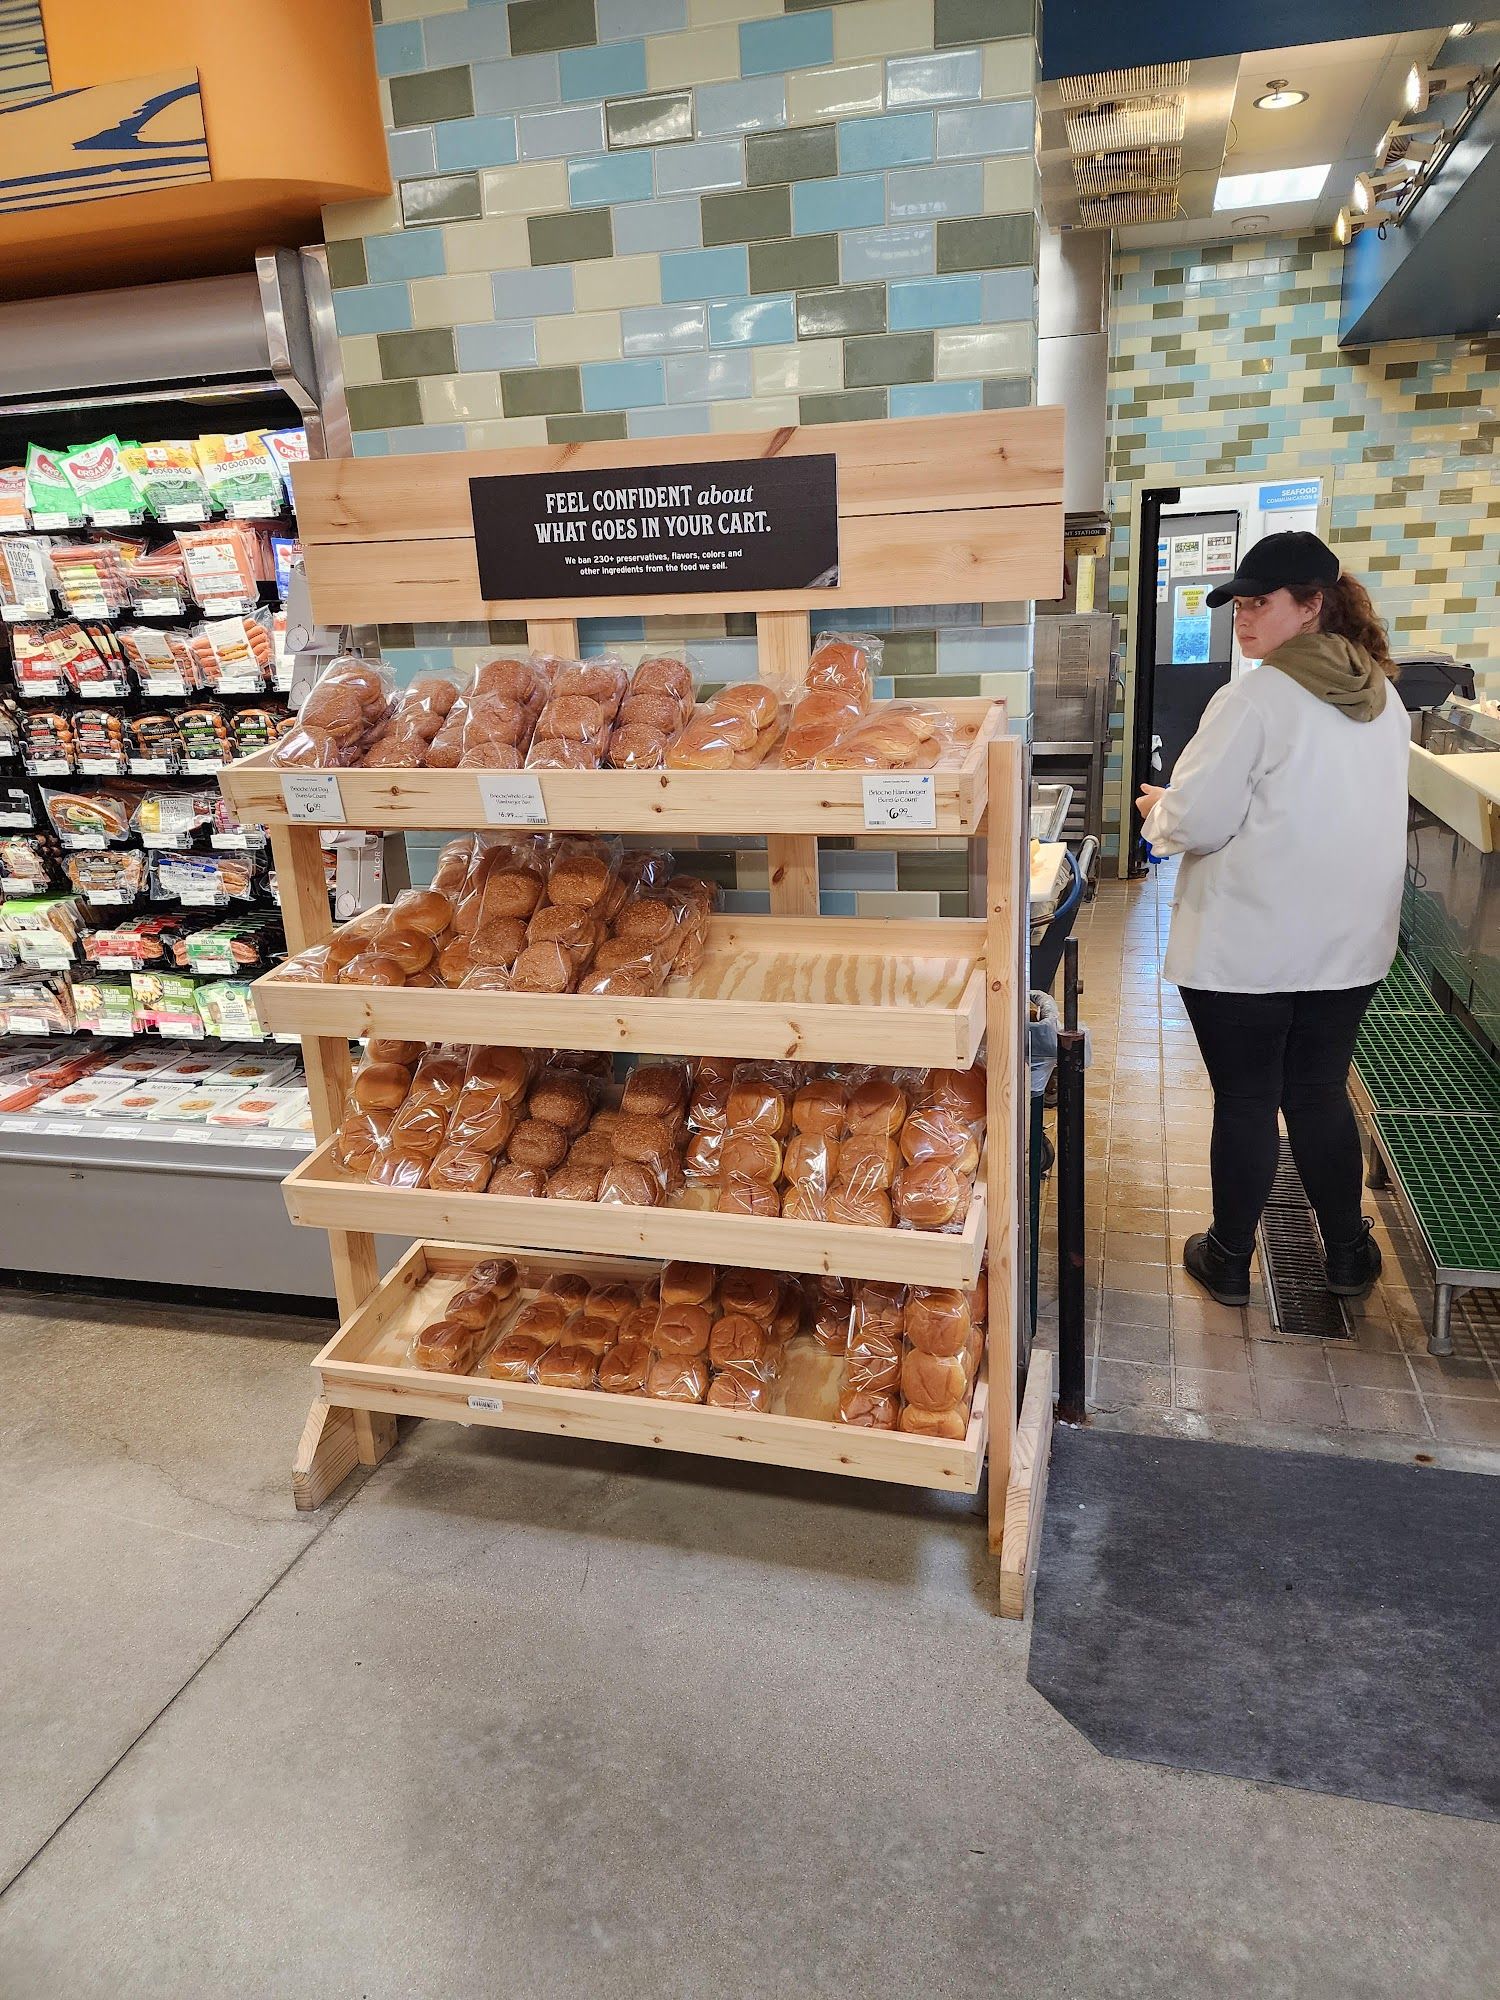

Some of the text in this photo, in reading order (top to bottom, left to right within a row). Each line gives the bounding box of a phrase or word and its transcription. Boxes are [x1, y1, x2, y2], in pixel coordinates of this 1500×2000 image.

[545, 484, 754, 514] FEEL CONFIDENT about
[1266, 494, 1313, 504] COMMUNICATION
[1281, 486, 1318, 497] SEAFOOD
[534, 511, 772, 544] WHAT GOES IN YOUR CART.
[564, 549, 743, 565] We ban 230+ preservatives, flavors, colors and
[580, 562, 728, 576] other ingredients from the food we sell.
[373, 851, 381, 883] TAYLOR
